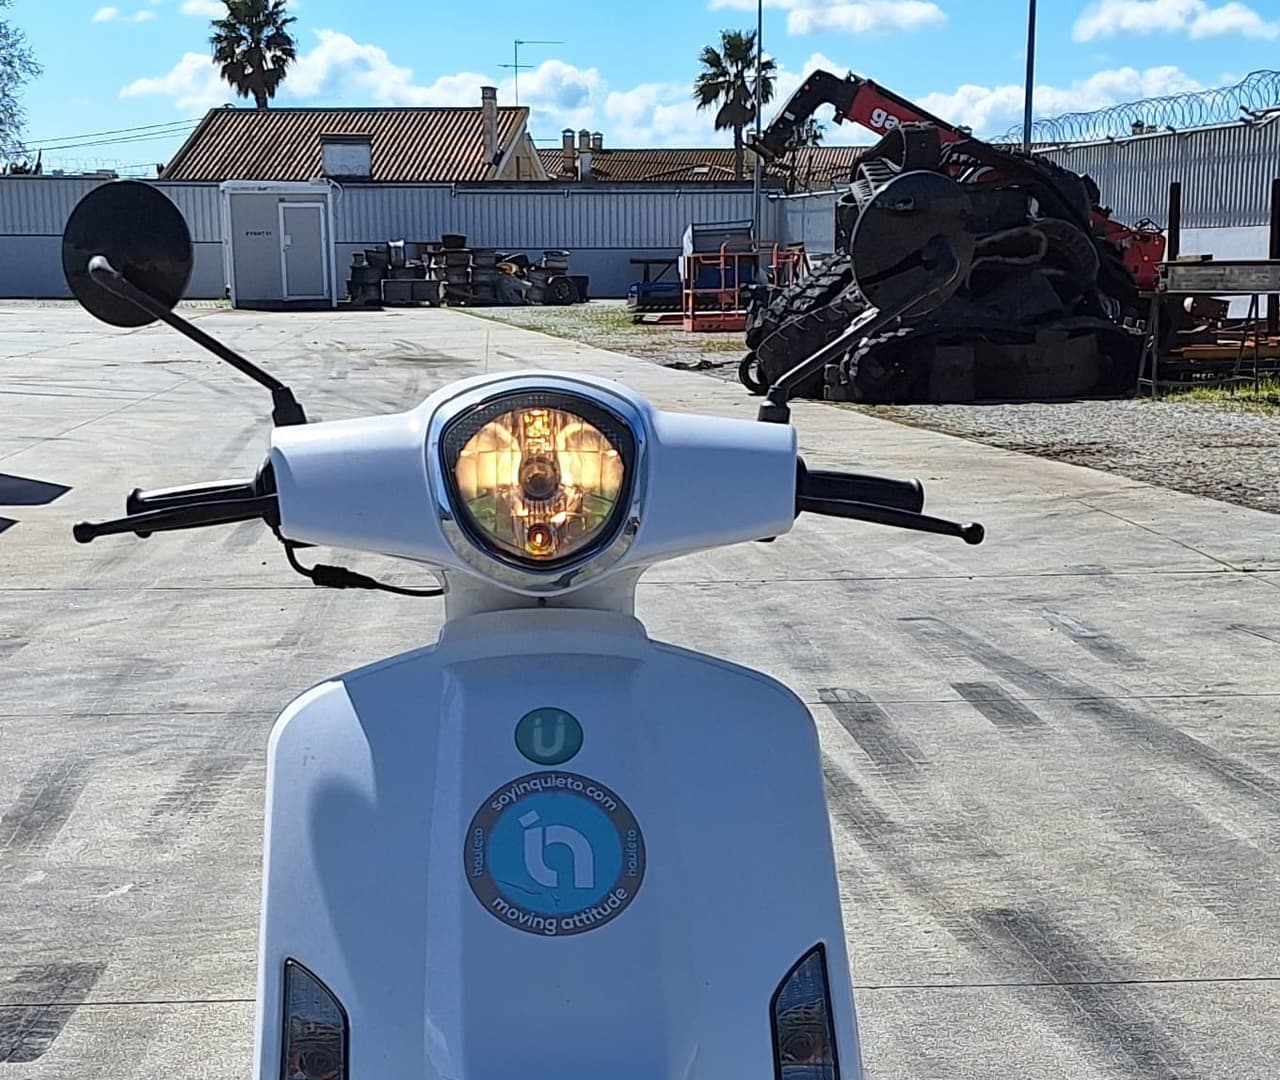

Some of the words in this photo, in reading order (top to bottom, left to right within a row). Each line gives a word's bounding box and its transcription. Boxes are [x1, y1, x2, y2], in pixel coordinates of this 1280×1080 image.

[870, 108, 900, 130] ga
[491, 773, 618, 812] soyinquieto.com
[491, 897, 557, 935] moving
[561, 887, 629, 930] attitude
